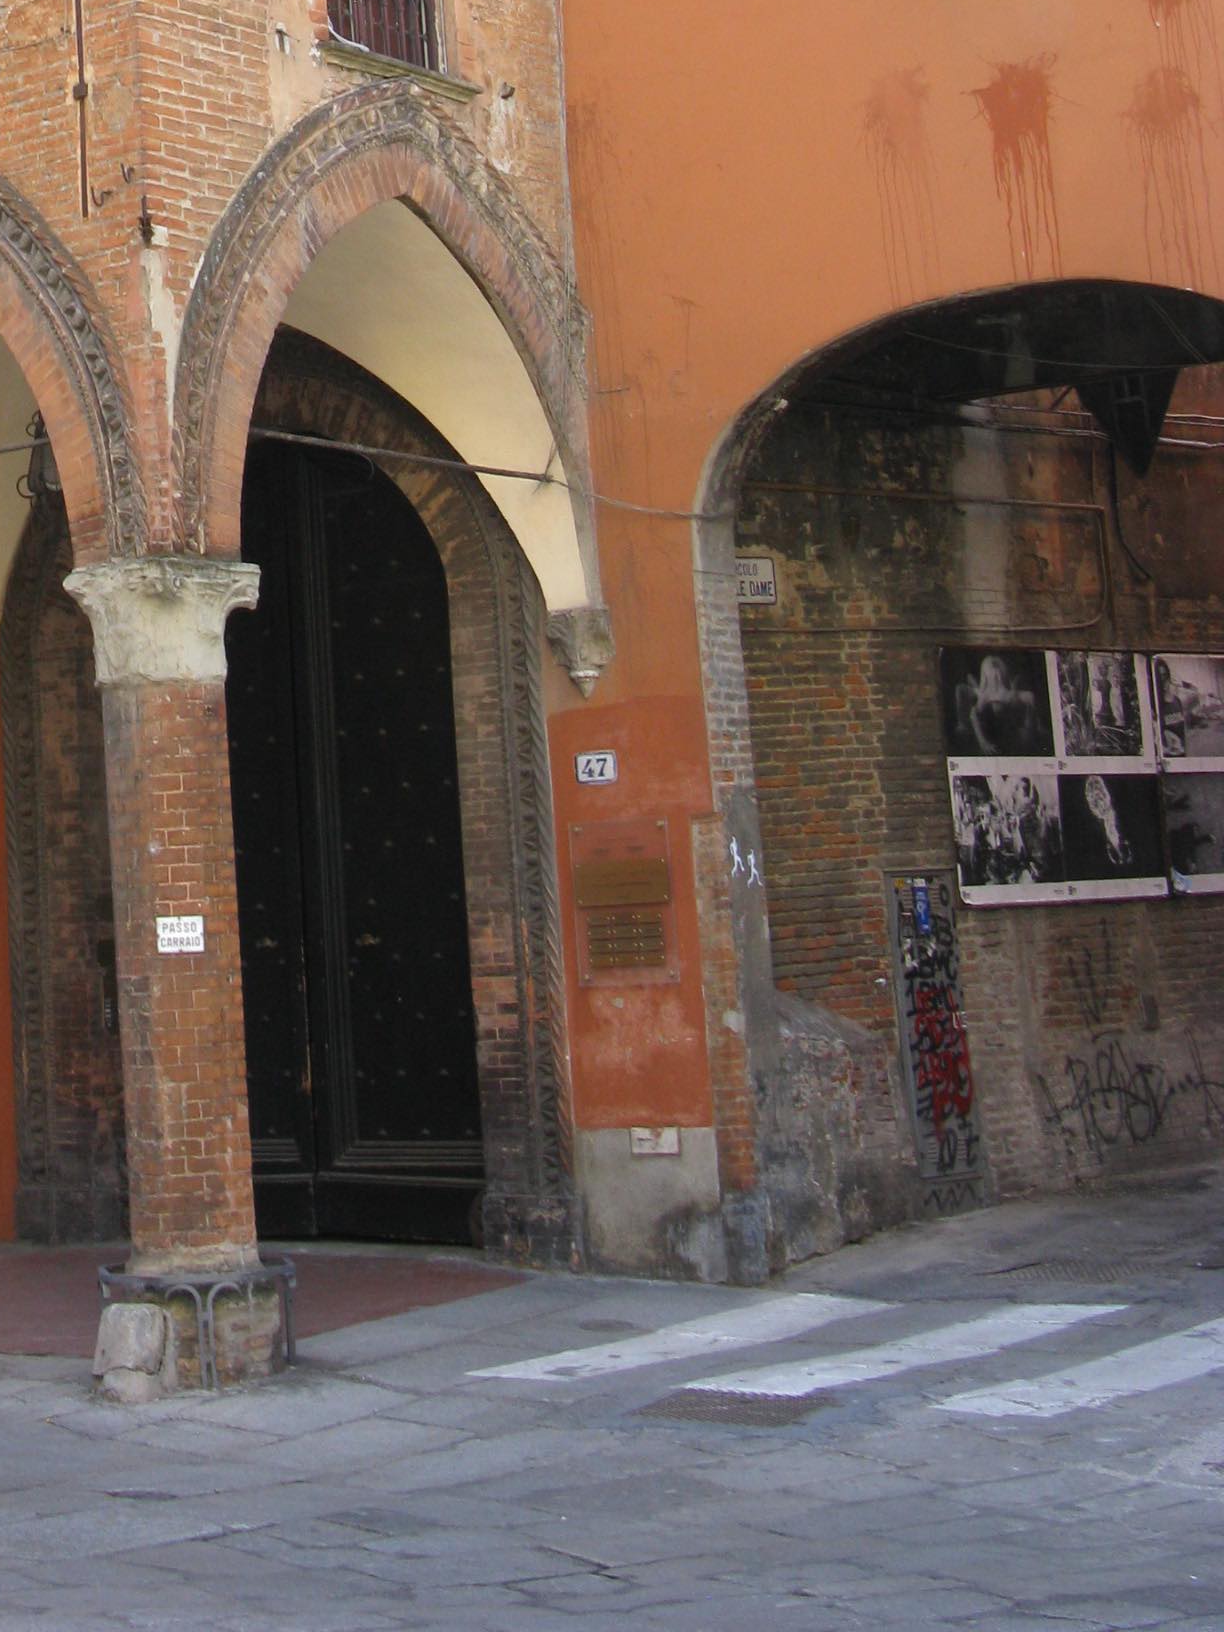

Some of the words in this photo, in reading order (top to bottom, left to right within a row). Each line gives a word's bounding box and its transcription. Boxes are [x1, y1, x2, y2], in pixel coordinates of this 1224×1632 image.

[749, 580, 774, 596] DAME
[581, 758, 607, 778] 47
[162, 921, 197, 934] PASSO
[160, 936, 201, 948] CARRAIO
